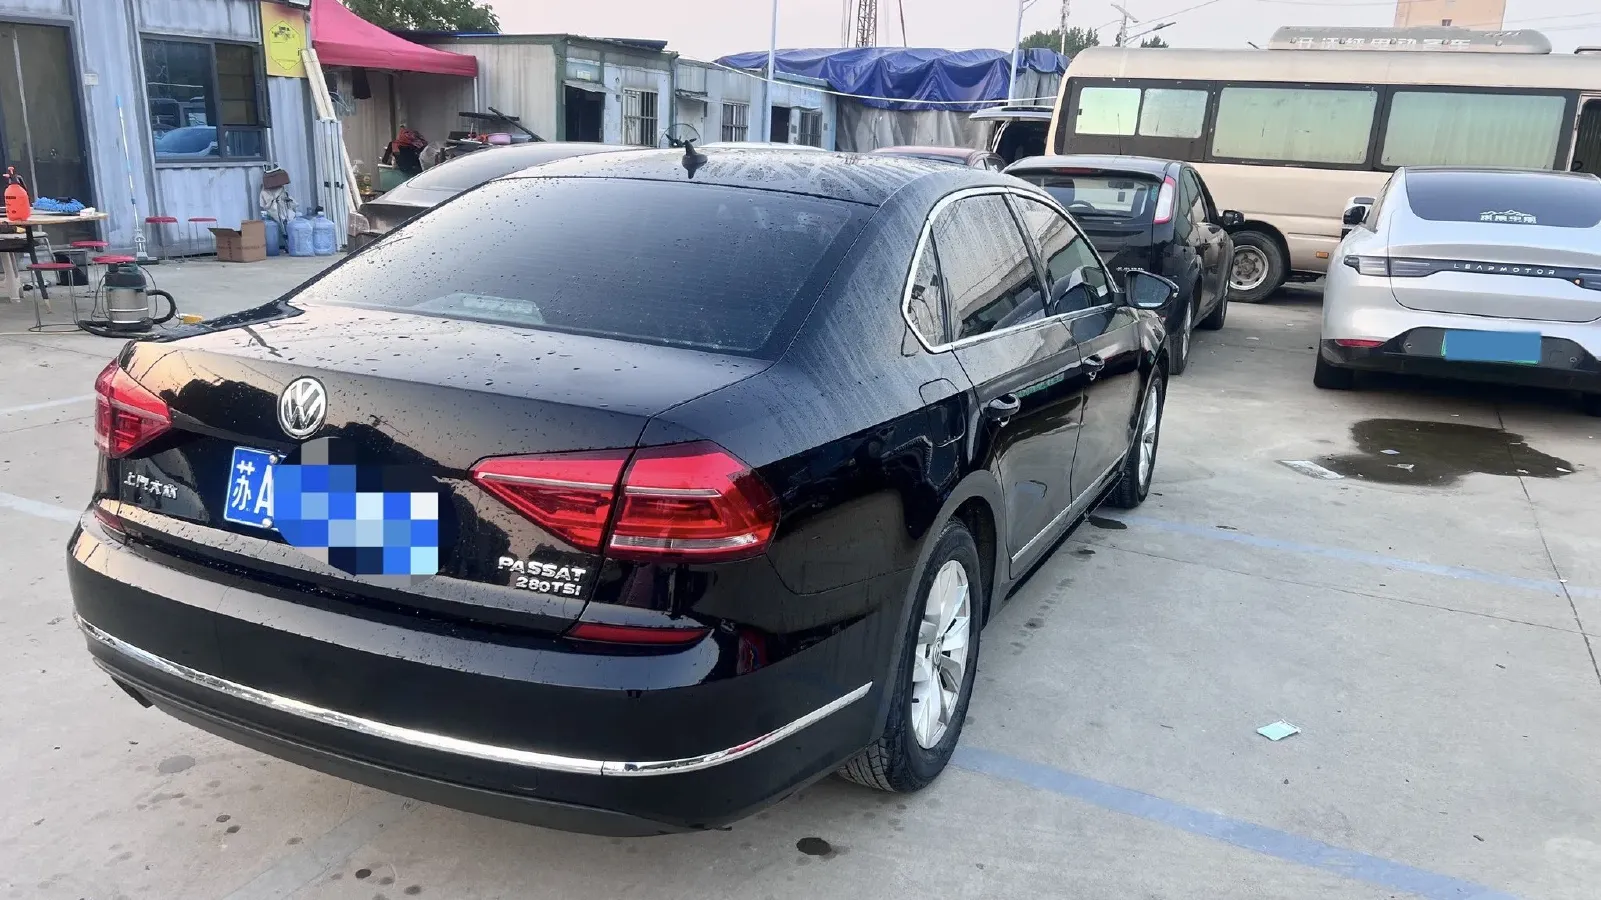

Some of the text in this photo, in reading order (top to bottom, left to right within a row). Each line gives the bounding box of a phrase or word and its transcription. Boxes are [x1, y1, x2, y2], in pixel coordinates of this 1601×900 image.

[1453, 262, 1556, 275] LEAPMOTOR
[498, 556, 587, 582] PASSAT
[515, 576, 582, 596] 280TSI
